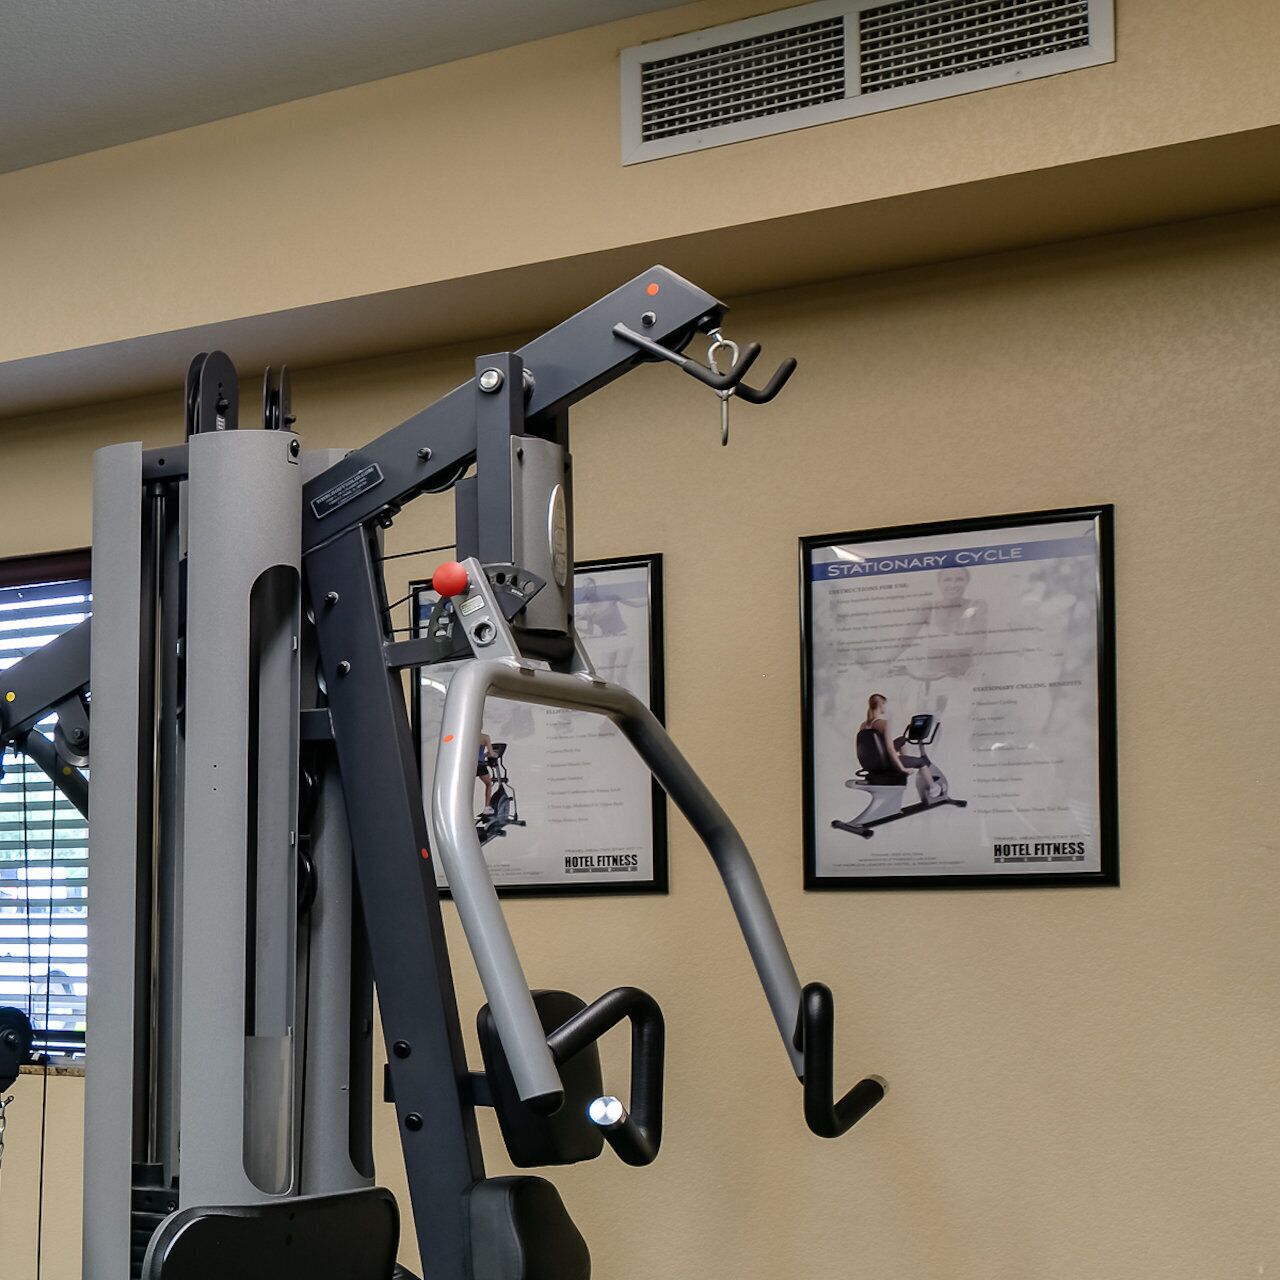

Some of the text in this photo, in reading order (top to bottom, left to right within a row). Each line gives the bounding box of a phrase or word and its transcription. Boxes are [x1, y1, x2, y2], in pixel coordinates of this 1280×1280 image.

[828, 548, 1023, 577] STATIONARY CYCLE
[994, 842, 1085, 857] HOTEL FITNESS
[564, 854, 638, 868] HOTEL FITNESS
